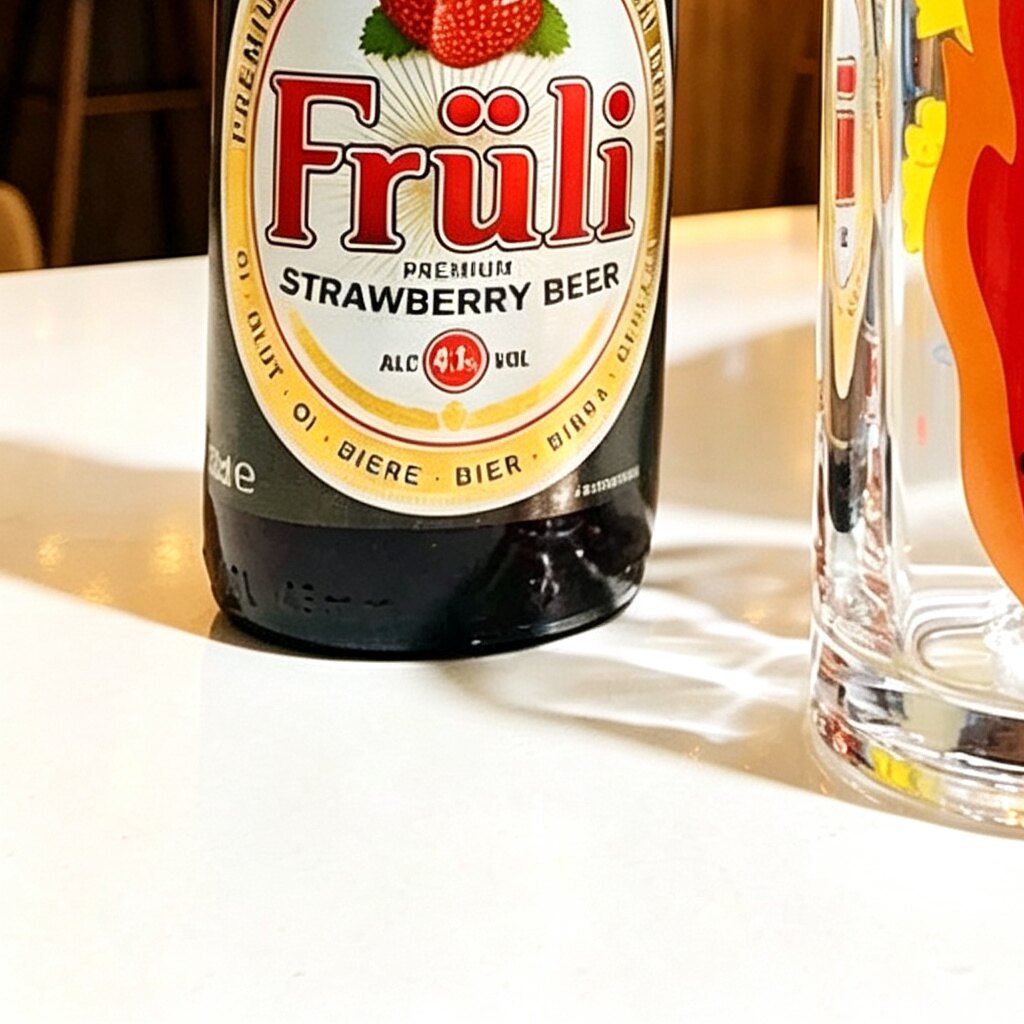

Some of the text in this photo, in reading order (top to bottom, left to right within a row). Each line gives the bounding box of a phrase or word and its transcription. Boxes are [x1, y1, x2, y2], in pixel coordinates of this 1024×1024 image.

[265, 71, 636, 254] Früli
[279, 261, 621, 317] STRAWBERRY BEER
[379, 353, 420, 373] ALC
[337, 439, 423, 486] BIERE
[455, 454, 522, 487] BIER
